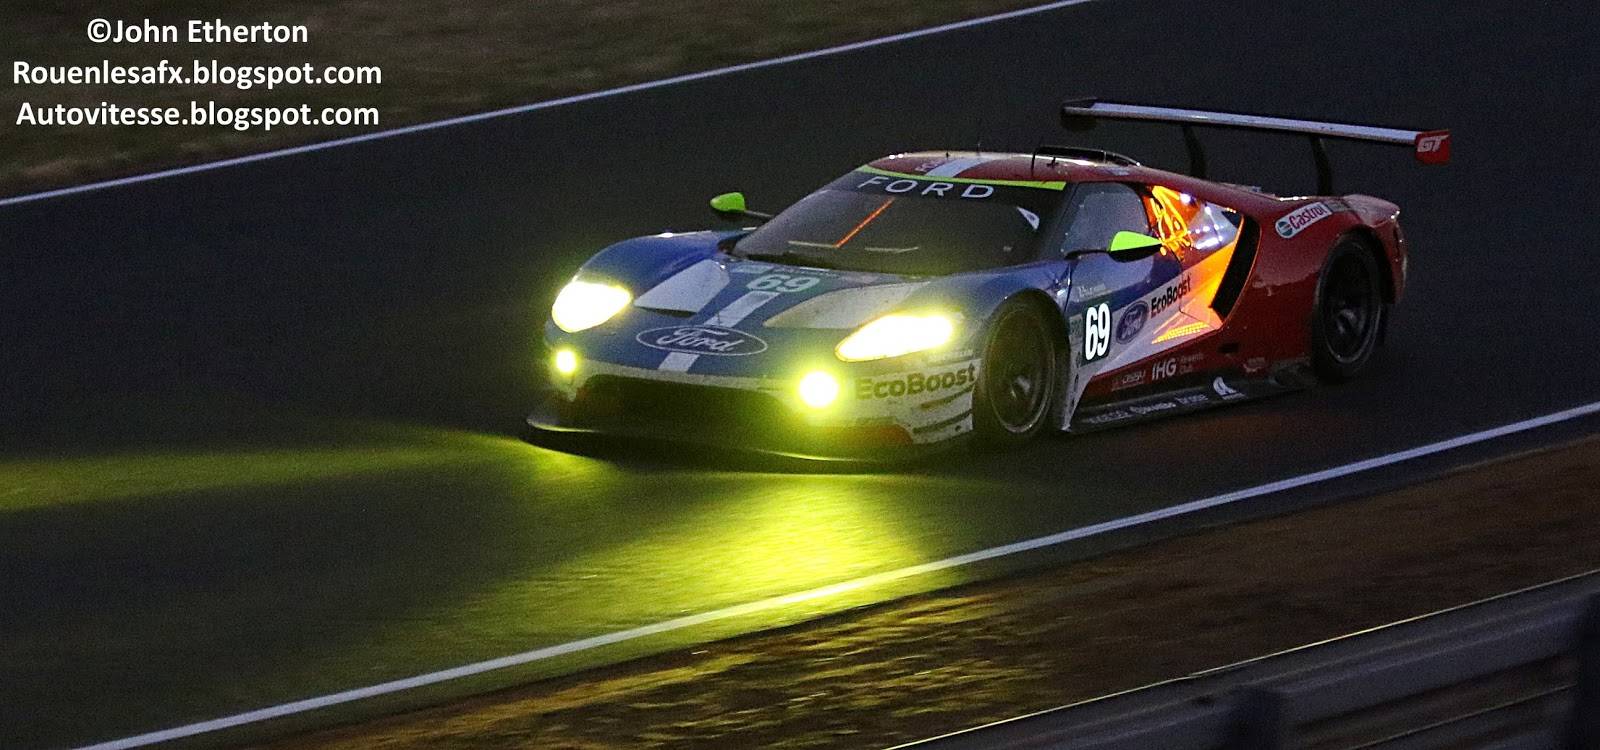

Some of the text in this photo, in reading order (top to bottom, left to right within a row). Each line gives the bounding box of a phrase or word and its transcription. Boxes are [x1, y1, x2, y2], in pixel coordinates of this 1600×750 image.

[1416, 134, 1450, 153] GT
[857, 175, 995, 198] FORD
[1289, 204, 1329, 230] Castrol
[746, 274, 821, 293] 69
[1151, 275, 1192, 317] EcoBoost
[656, 326, 743, 352] Ford
[1085, 302, 1111, 361] 69
[855, 362, 976, 400] EcoBoost
[1151, 358, 1177, 381] IHG
